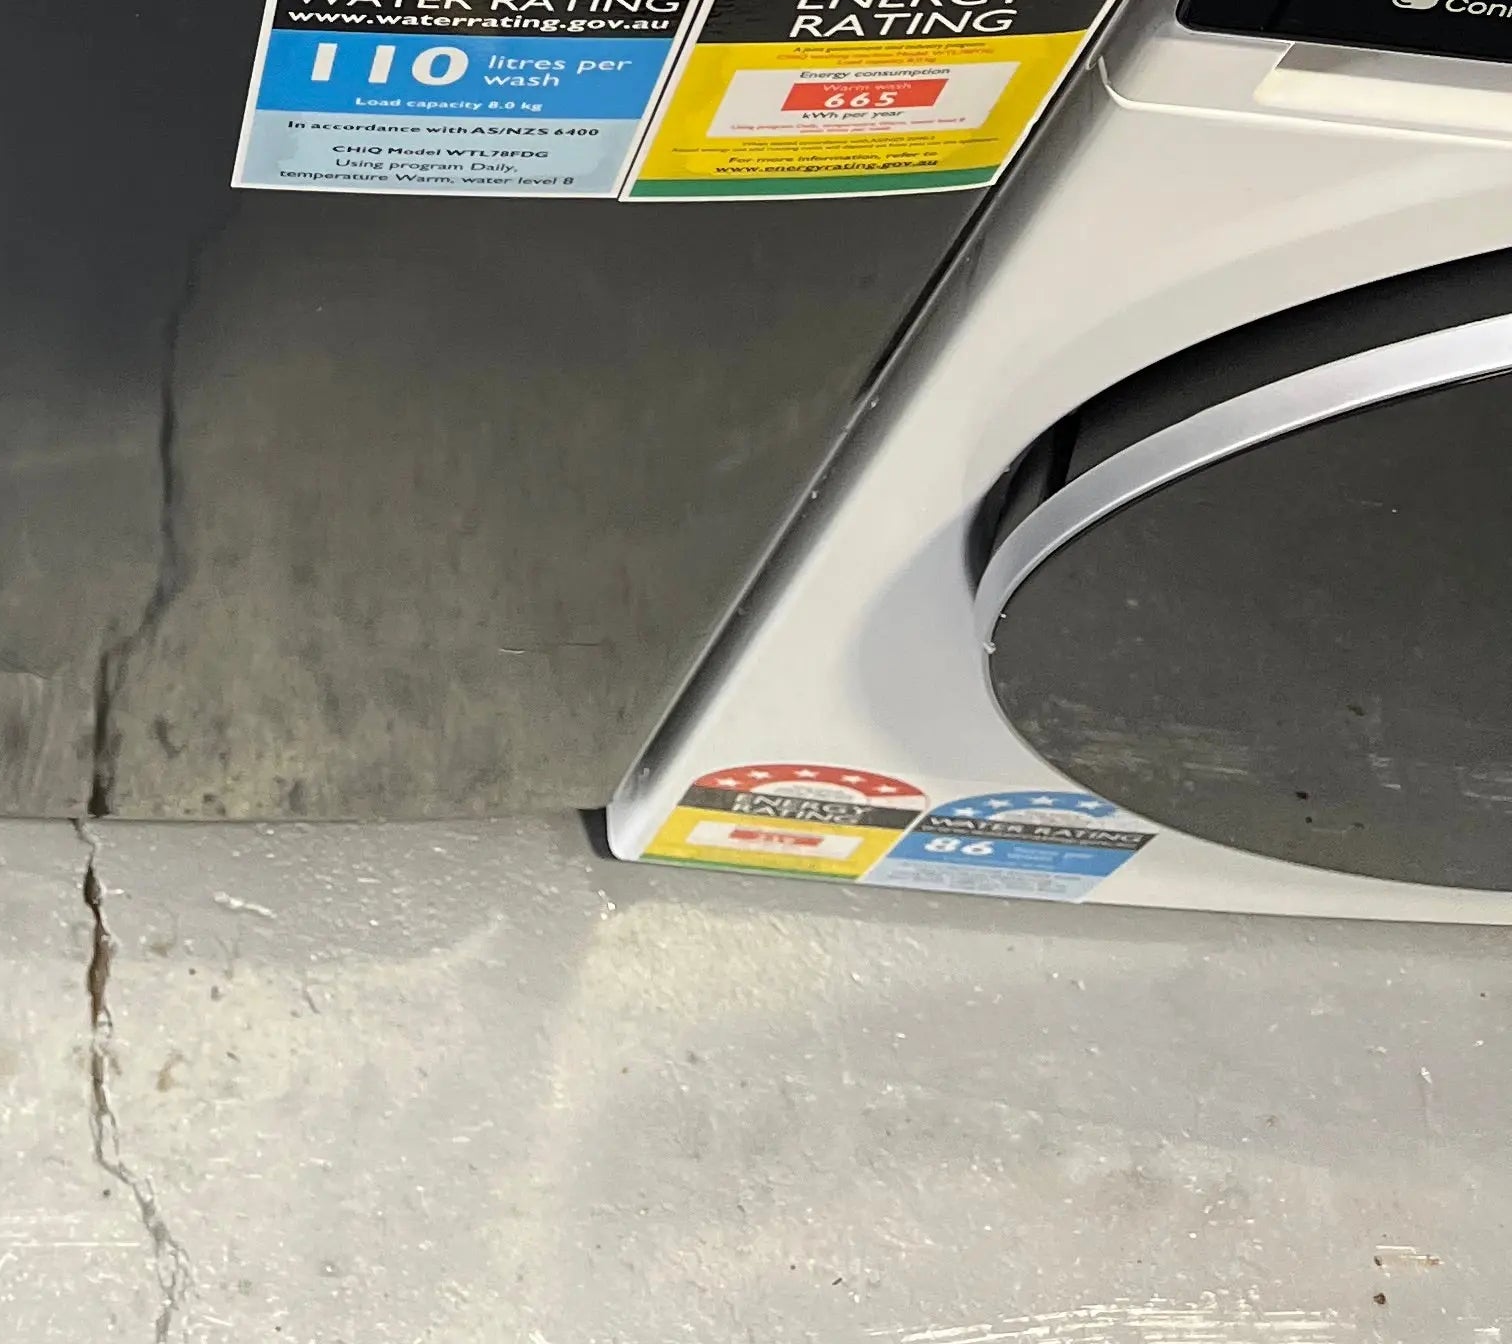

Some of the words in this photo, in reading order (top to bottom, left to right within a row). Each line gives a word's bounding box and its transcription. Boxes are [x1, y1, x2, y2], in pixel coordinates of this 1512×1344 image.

[288, 10, 670, 33] www.waterrating.gov.au
[788, 9, 1019, 39] RATING
[310, 41, 470, 87] 110
[489, 55, 566, 72] litres
[577, 58, 632, 75] per
[483, 72, 560, 88] wash
[800, 70, 851, 80] Energy
[854, 68, 951, 78] consumption
[823, 84, 871, 92] Warm
[355, 97, 401, 107] Load
[406, 98, 483, 111] capacity
[488, 99, 515, 110] 8.0
[520, 101, 543, 112] kg
[823, 91, 898, 109] 665
[802, 111, 839, 120] kWh
[842, 111, 869, 121] per
[872, 110, 904, 119] year
[288, 120, 307, 130] In
[311, 122, 421, 133] accordance
[426, 123, 467, 134] with
[466, 125, 549, 136] AS/NZS
[554, 127, 600, 137] 6400
[388, 146, 441, 156] Model
[446, 149, 549, 159] WTL78FDG
[335, 158, 385, 171] Using
[389, 160, 465, 173] program
[470, 162, 519, 175] Daily,
[280, 170, 389, 183] temperature
[462, 176, 512, 185] water
[517, 176, 558, 186] level
[734, 793, 874, 815] ENERGY
[731, 802, 862, 825] RATING
[930, 816, 1024, 834] WATER
[1033, 825, 1144, 844] RATING
[924, 836, 995, 856] 86
